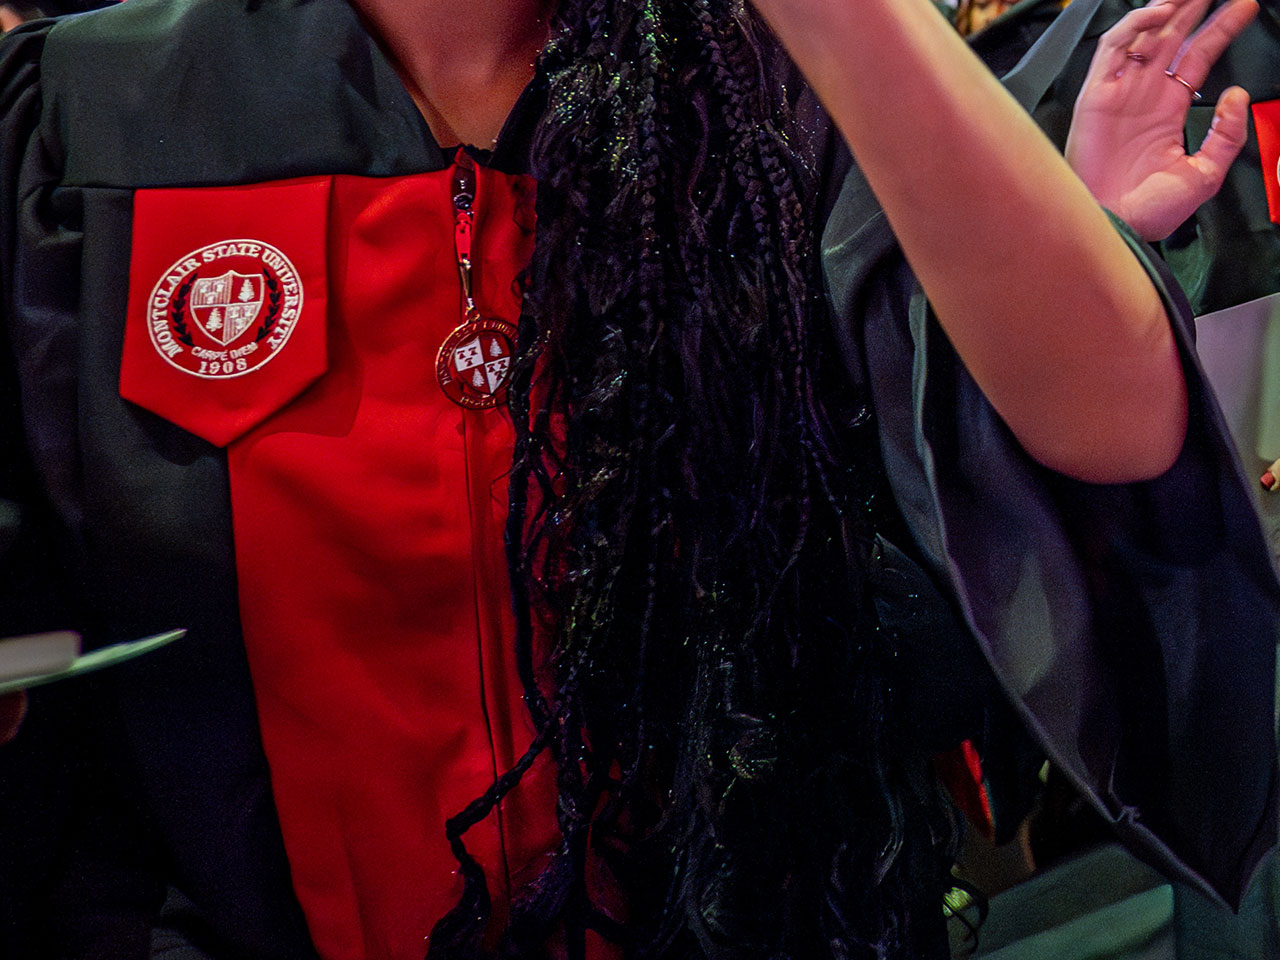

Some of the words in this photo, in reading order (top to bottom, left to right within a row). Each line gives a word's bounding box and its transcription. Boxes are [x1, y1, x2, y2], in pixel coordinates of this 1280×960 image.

[151, 257, 202, 358] MONTCLAIR
[202, 243, 262, 263] STATE
[261, 249, 302, 351] UNIVERSITY
[191, 346, 228, 361] CARPE
[229, 342, 259, 359] DIEM
[198, 358, 248, 374] 1908
